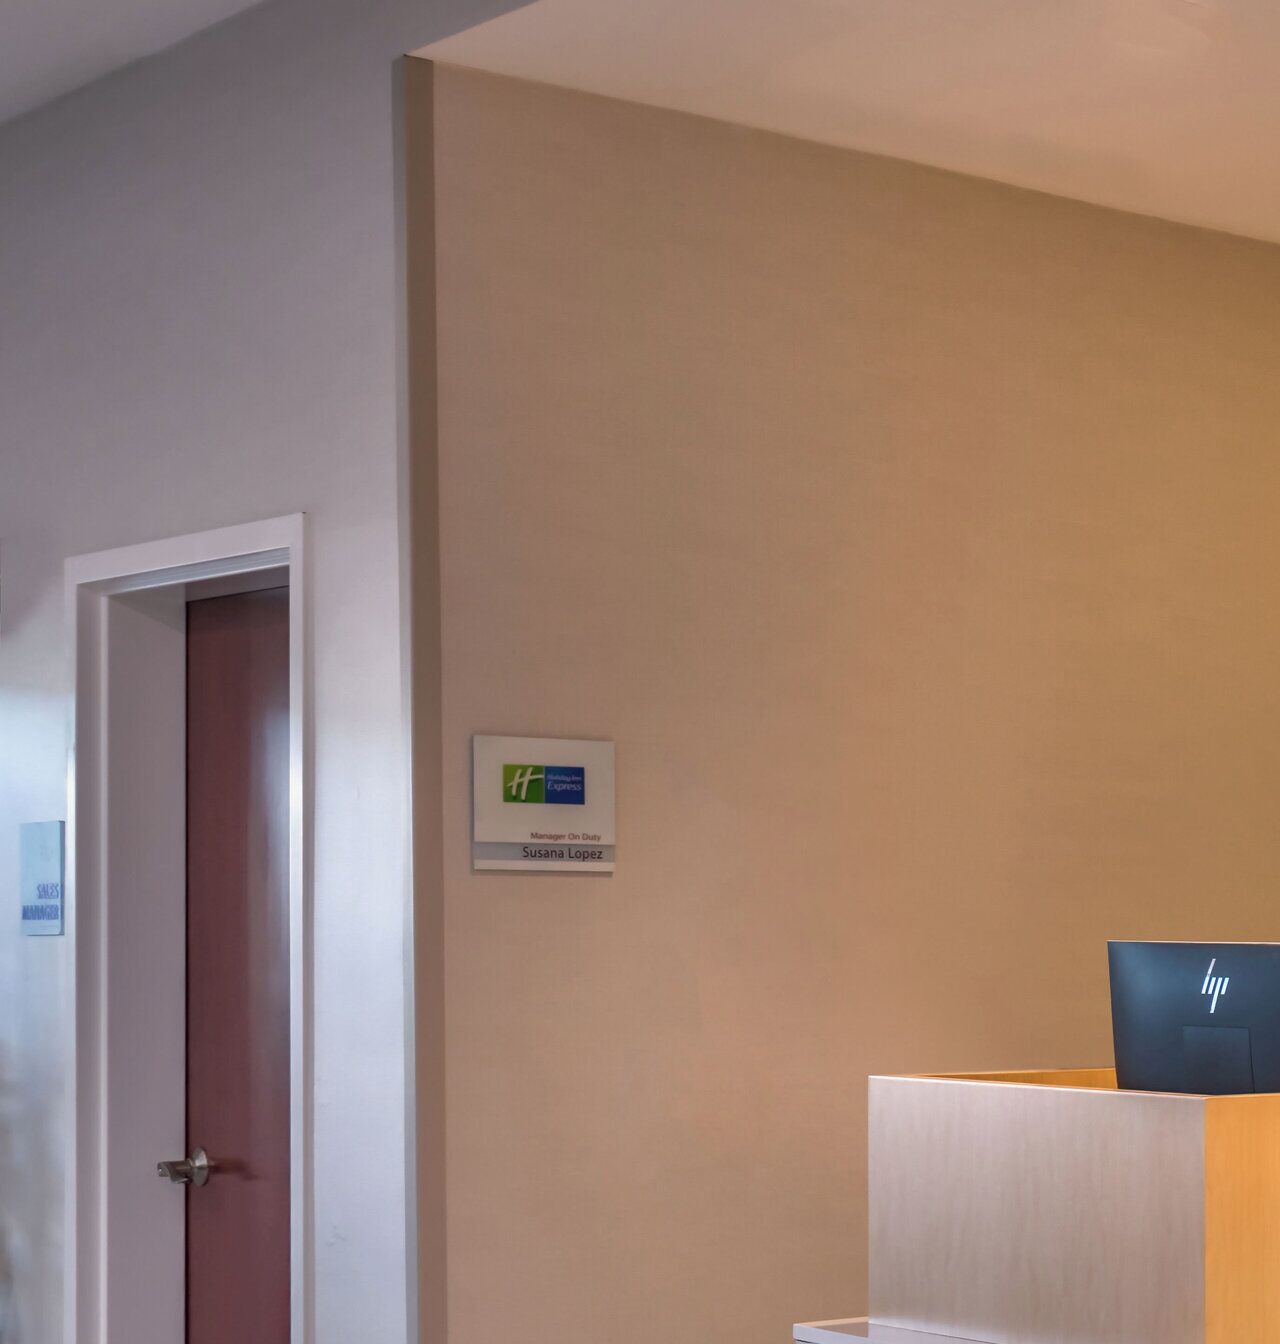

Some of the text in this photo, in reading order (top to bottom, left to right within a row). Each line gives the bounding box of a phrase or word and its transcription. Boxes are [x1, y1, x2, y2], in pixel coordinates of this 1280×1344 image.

[547, 781, 582, 791] Express
[530, 832, 566, 842] Manager
[582, 833, 602, 842] Duty
[522, 846, 603, 861] Susana Lopez
[1201, 958, 1230, 1014] hp
